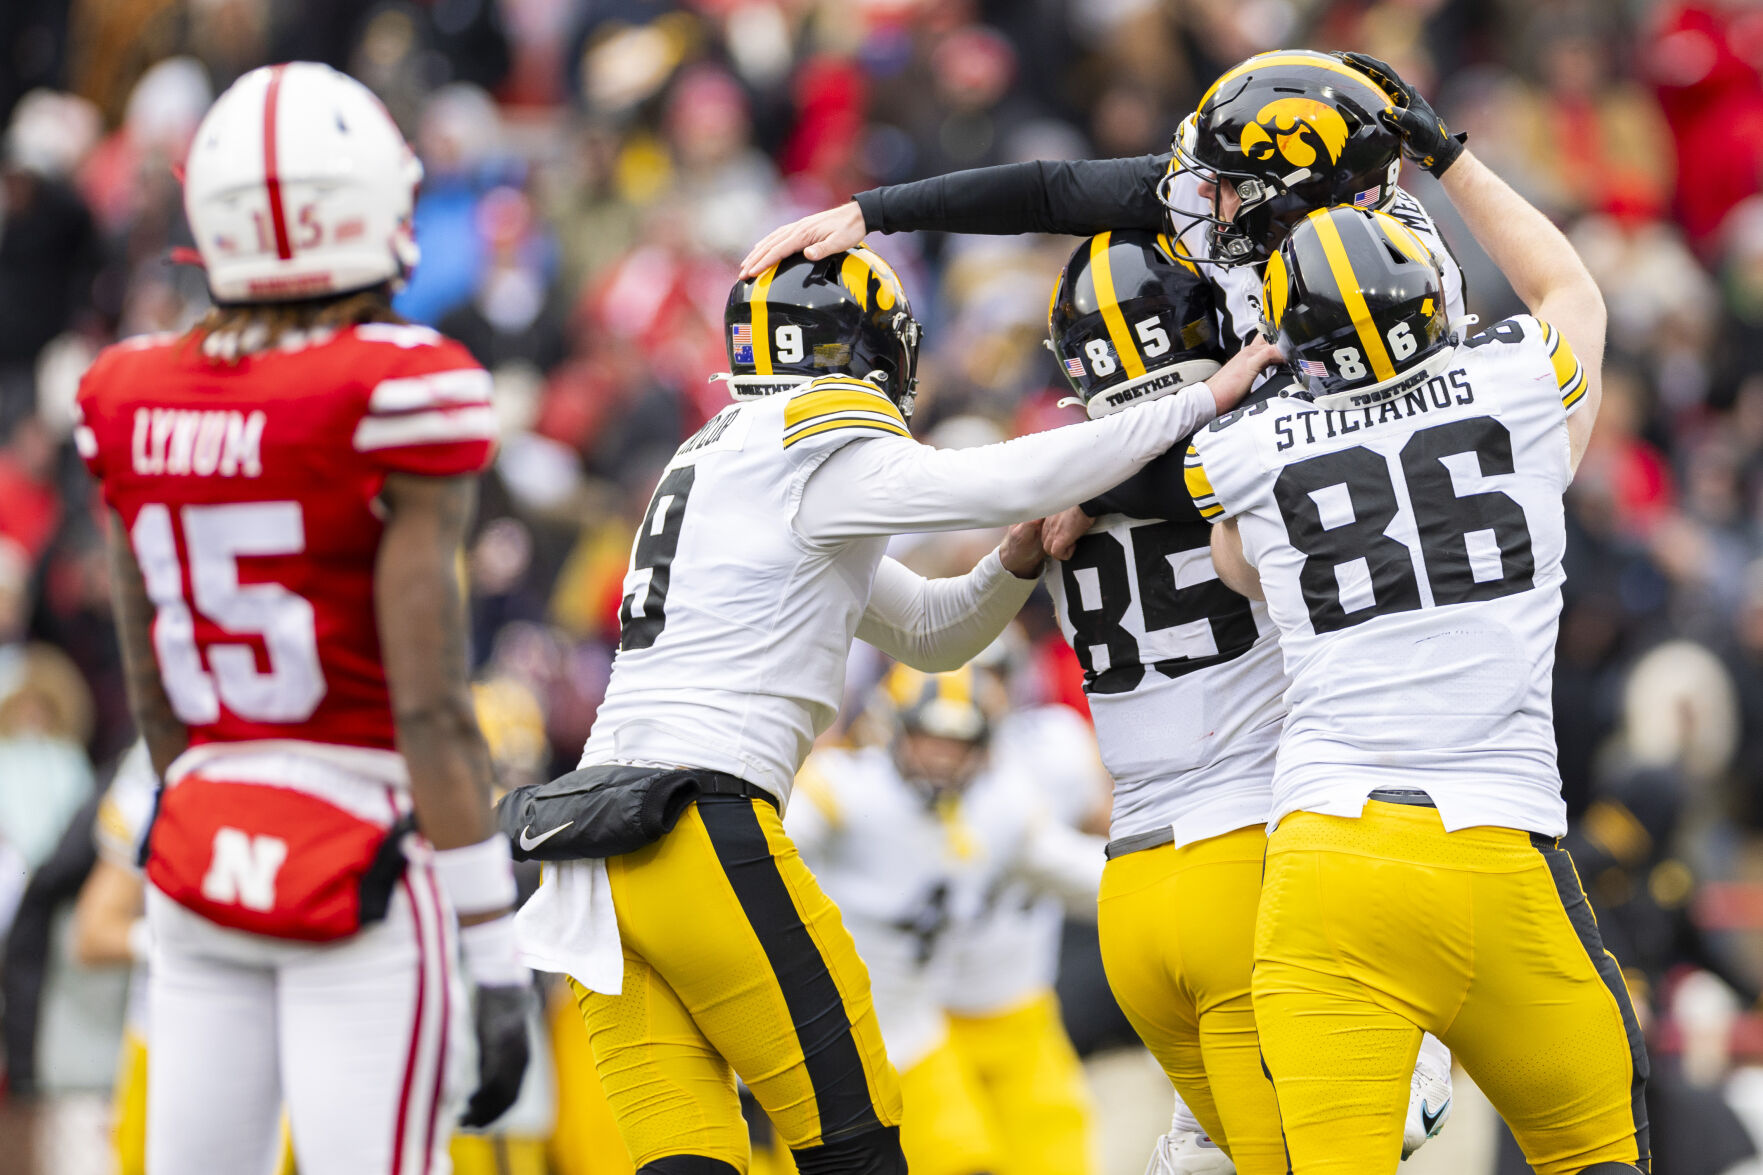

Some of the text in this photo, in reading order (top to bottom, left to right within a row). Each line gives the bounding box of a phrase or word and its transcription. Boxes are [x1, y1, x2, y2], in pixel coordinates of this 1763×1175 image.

[253, 204, 323, 254] 15
[775, 324, 804, 364] 9
[1085, 315, 1171, 377] 85
[1332, 321, 1418, 381] 86
[1105, 371, 1184, 407] TOGETHER
[1275, 368, 1475, 451] STILIANOS
[1350, 369, 1430, 407] TOGETHER
[131, 407, 267, 478] LYNUM
[621, 464, 696, 652] 9
[1273, 415, 1535, 635] 86
[131, 500, 328, 725] 15
[1061, 520, 1260, 695] 85
[203, 826, 287, 913] N
